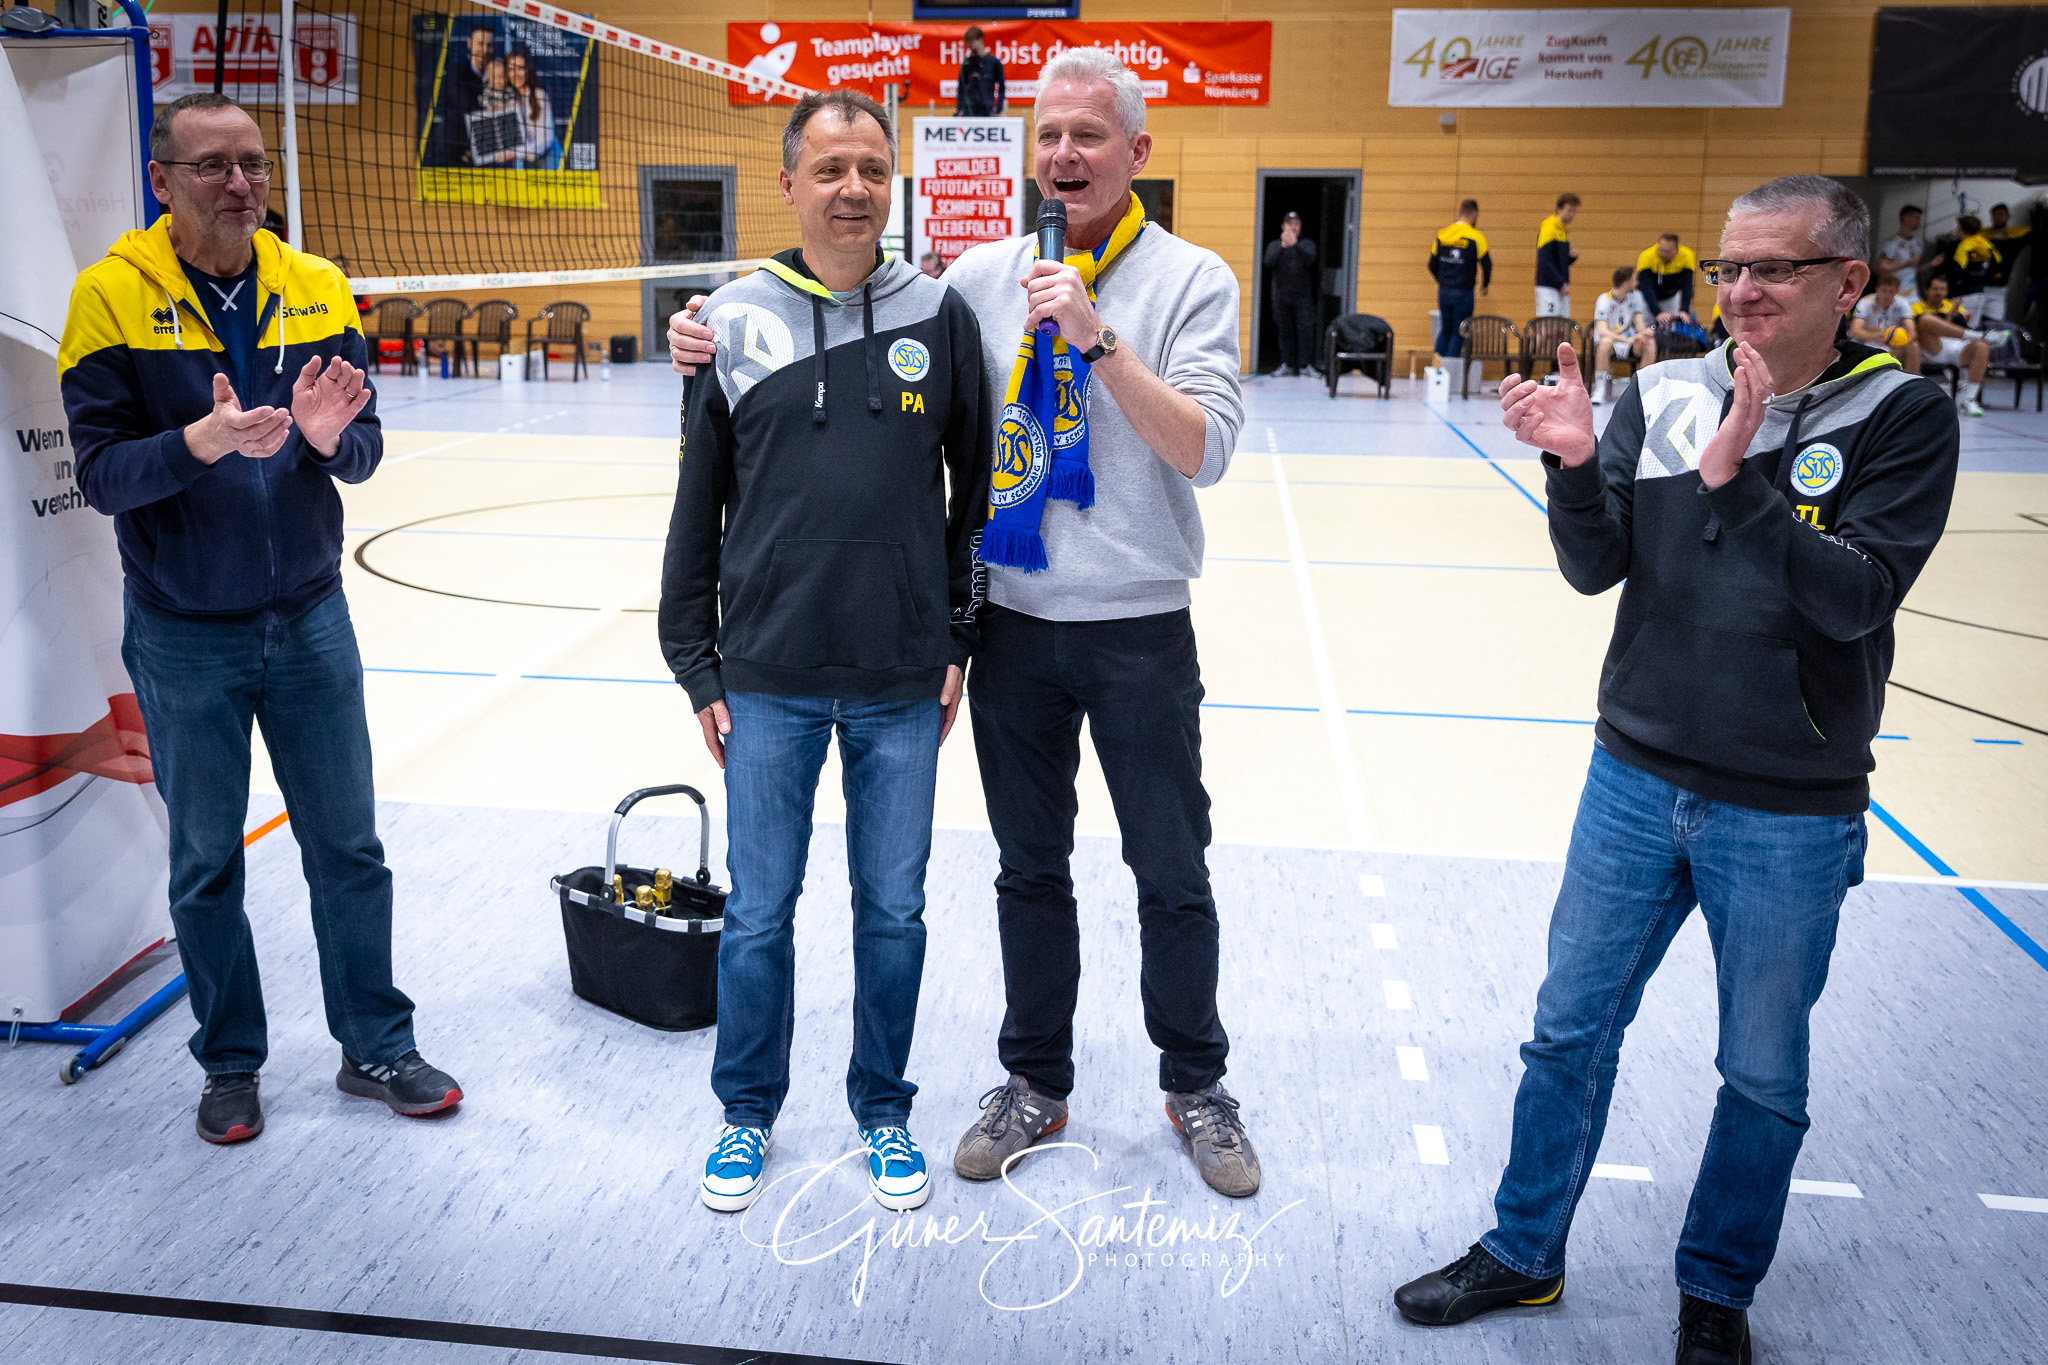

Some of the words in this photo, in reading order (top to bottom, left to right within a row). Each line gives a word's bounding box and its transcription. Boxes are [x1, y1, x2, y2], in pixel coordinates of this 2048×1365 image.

[810, 32, 922, 58] Teamplayer
[1713, 35, 1773, 55] JAHRE
[939, 40, 992, 66] Hi
[995, 40, 1042, 66] bist
[1046, 39, 1070, 63] d
[1090, 39, 1169, 71] htig.
[1403, 36, 1472, 79] 40
[1477, 35, 1525, 50] JAHRE
[1538, 52, 1584, 64] kommt
[1587, 54, 1613, 64] von
[827, 55, 911, 85] gesucht!
[1477, 56, 1520, 80] IGE
[1544, 68, 1605, 80] Herkunft
[1204, 71, 1262, 85] Sparkasse
[1204, 86, 1259, 100] Nürnberg
[924, 127, 1012, 142] MEYSEL
[937, 159, 997, 177] SCHILDER
[924, 178, 1008, 197] FOTOTAPETEN
[936, 198, 1000, 217] SCHRIFTEN
[928, 218, 1008, 237] KLEBEFOLIEN
[282, 302, 329, 319] Schwaig
[814, 381, 826, 408] Kempa
[901, 391, 925, 414] PA
[16, 428, 64, 452] Wenn
[1796, 504, 1826, 530] TL
